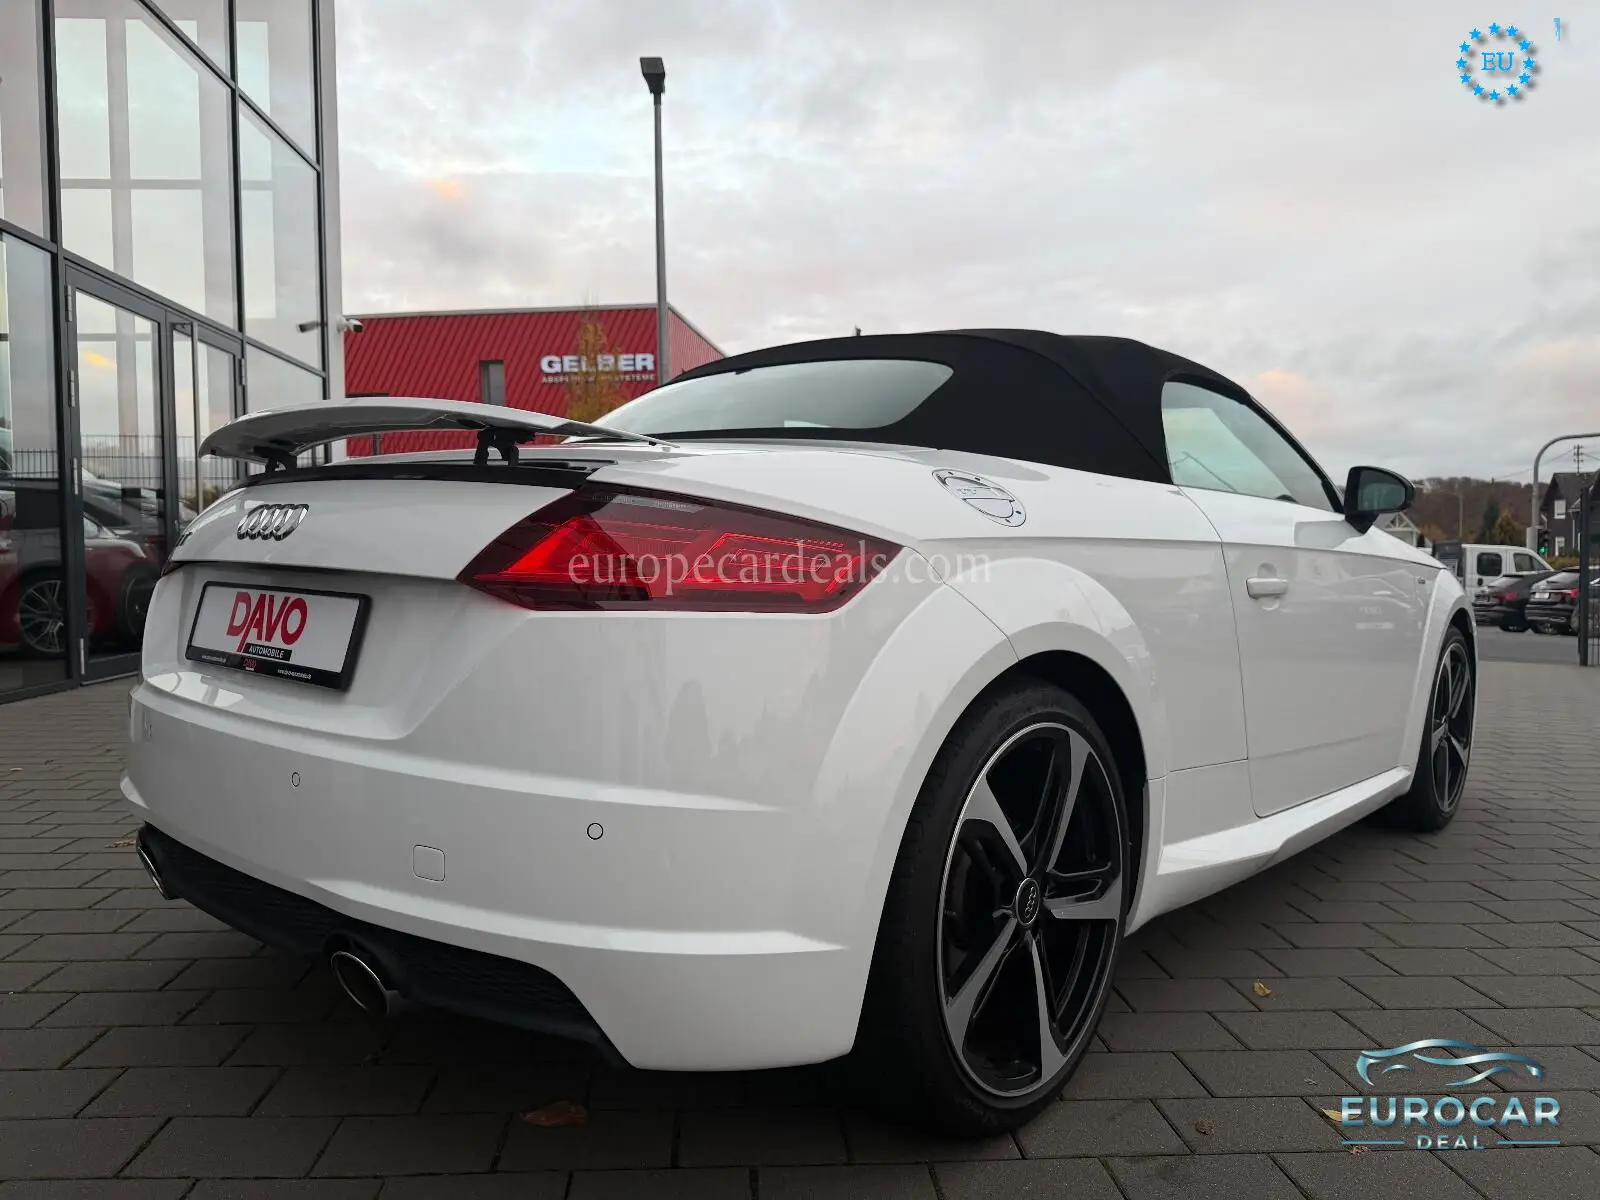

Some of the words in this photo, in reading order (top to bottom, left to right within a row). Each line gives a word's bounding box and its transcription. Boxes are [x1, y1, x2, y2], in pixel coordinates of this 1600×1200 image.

[541, 353, 655, 373] GELBER
[226, 592, 308, 652] DAVO
[249, 645, 285, 659] AUTOMOBILE
